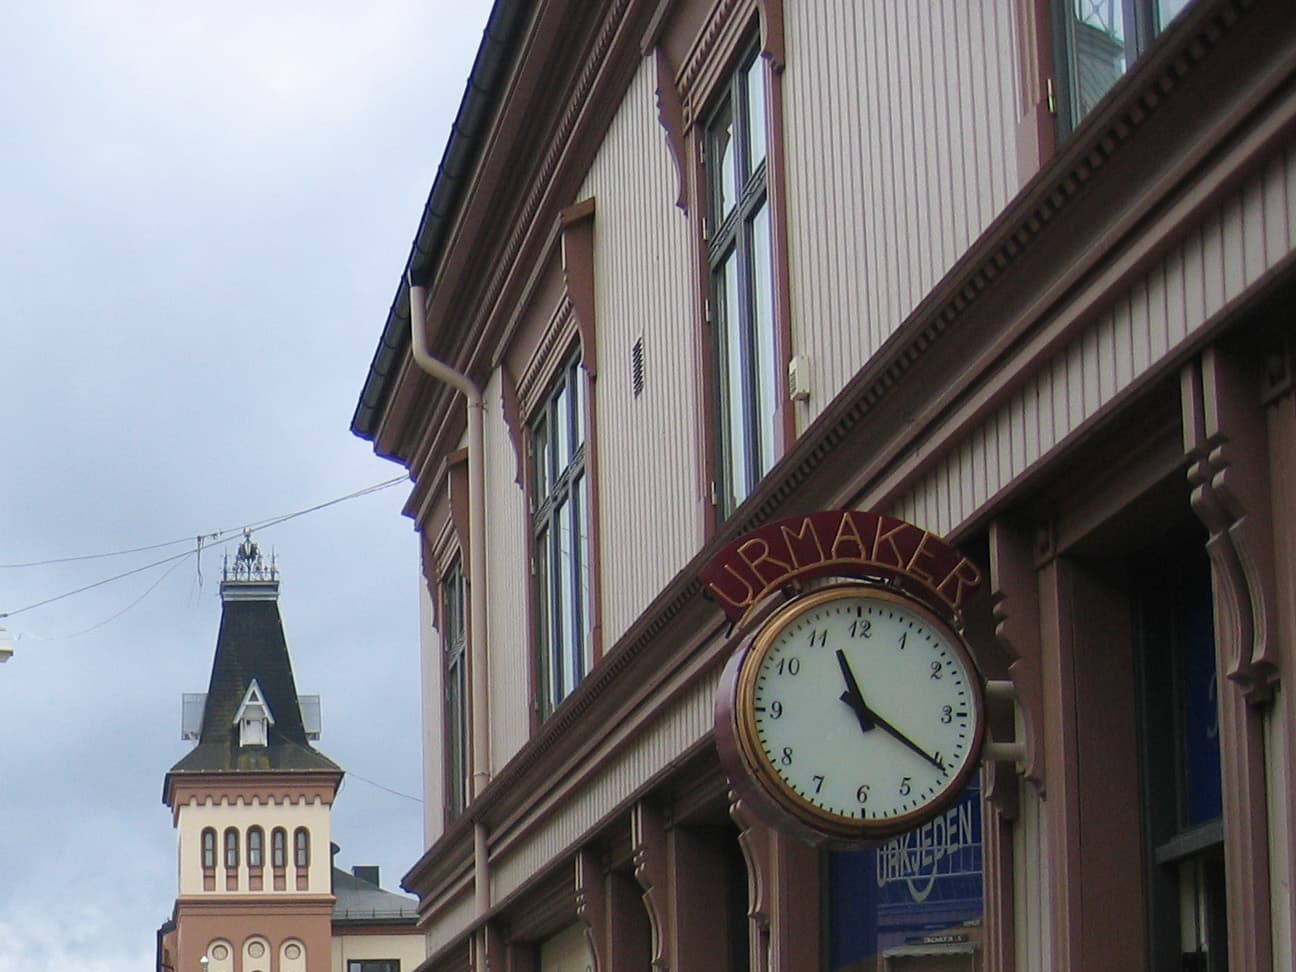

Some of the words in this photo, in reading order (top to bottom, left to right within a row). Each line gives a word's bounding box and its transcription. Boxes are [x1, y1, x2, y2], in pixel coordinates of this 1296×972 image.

[709, 512, 982, 608] URMAKER
[808, 628, 828, 648] 11
[848, 619, 873, 639] 12
[898, 632, 908, 650] 1
[776, 657, 801, 676] 10
[929, 661, 944, 680] 2
[769, 701, 783, 720] 9
[940, 705, 954, 724] 3
[781, 747, 794, 766] 8
[812, 775, 825, 794] 7
[899, 777, 913, 796] 5
[856, 785, 871, 804] 6
